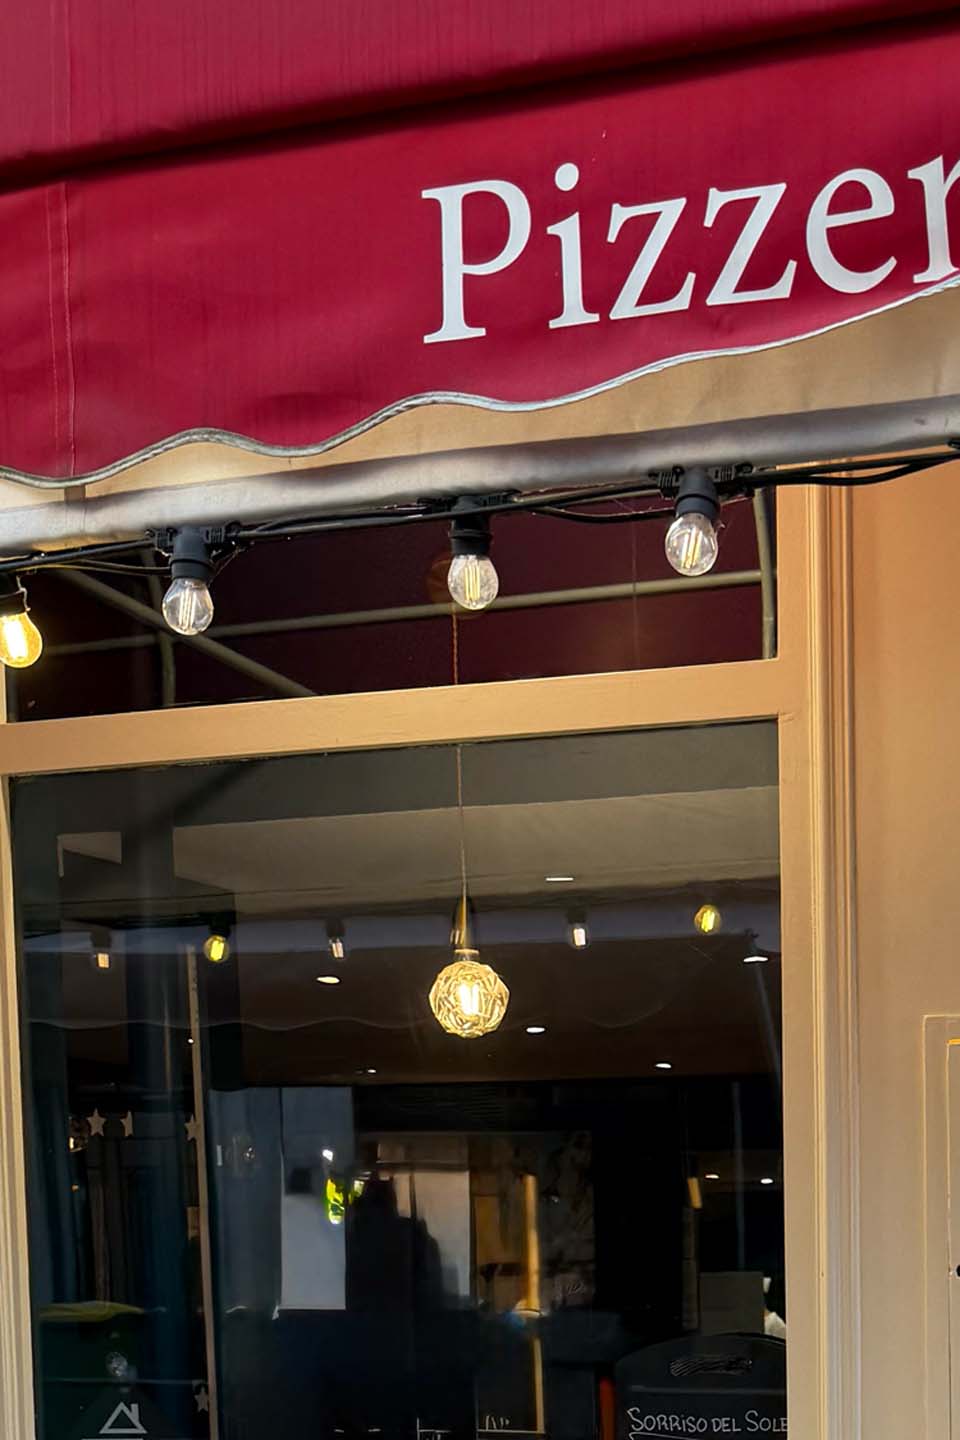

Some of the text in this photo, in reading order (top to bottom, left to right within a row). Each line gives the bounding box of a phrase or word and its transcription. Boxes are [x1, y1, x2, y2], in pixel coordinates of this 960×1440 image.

[627, 1407, 789, 1433] SORRISO DEL SOLE
